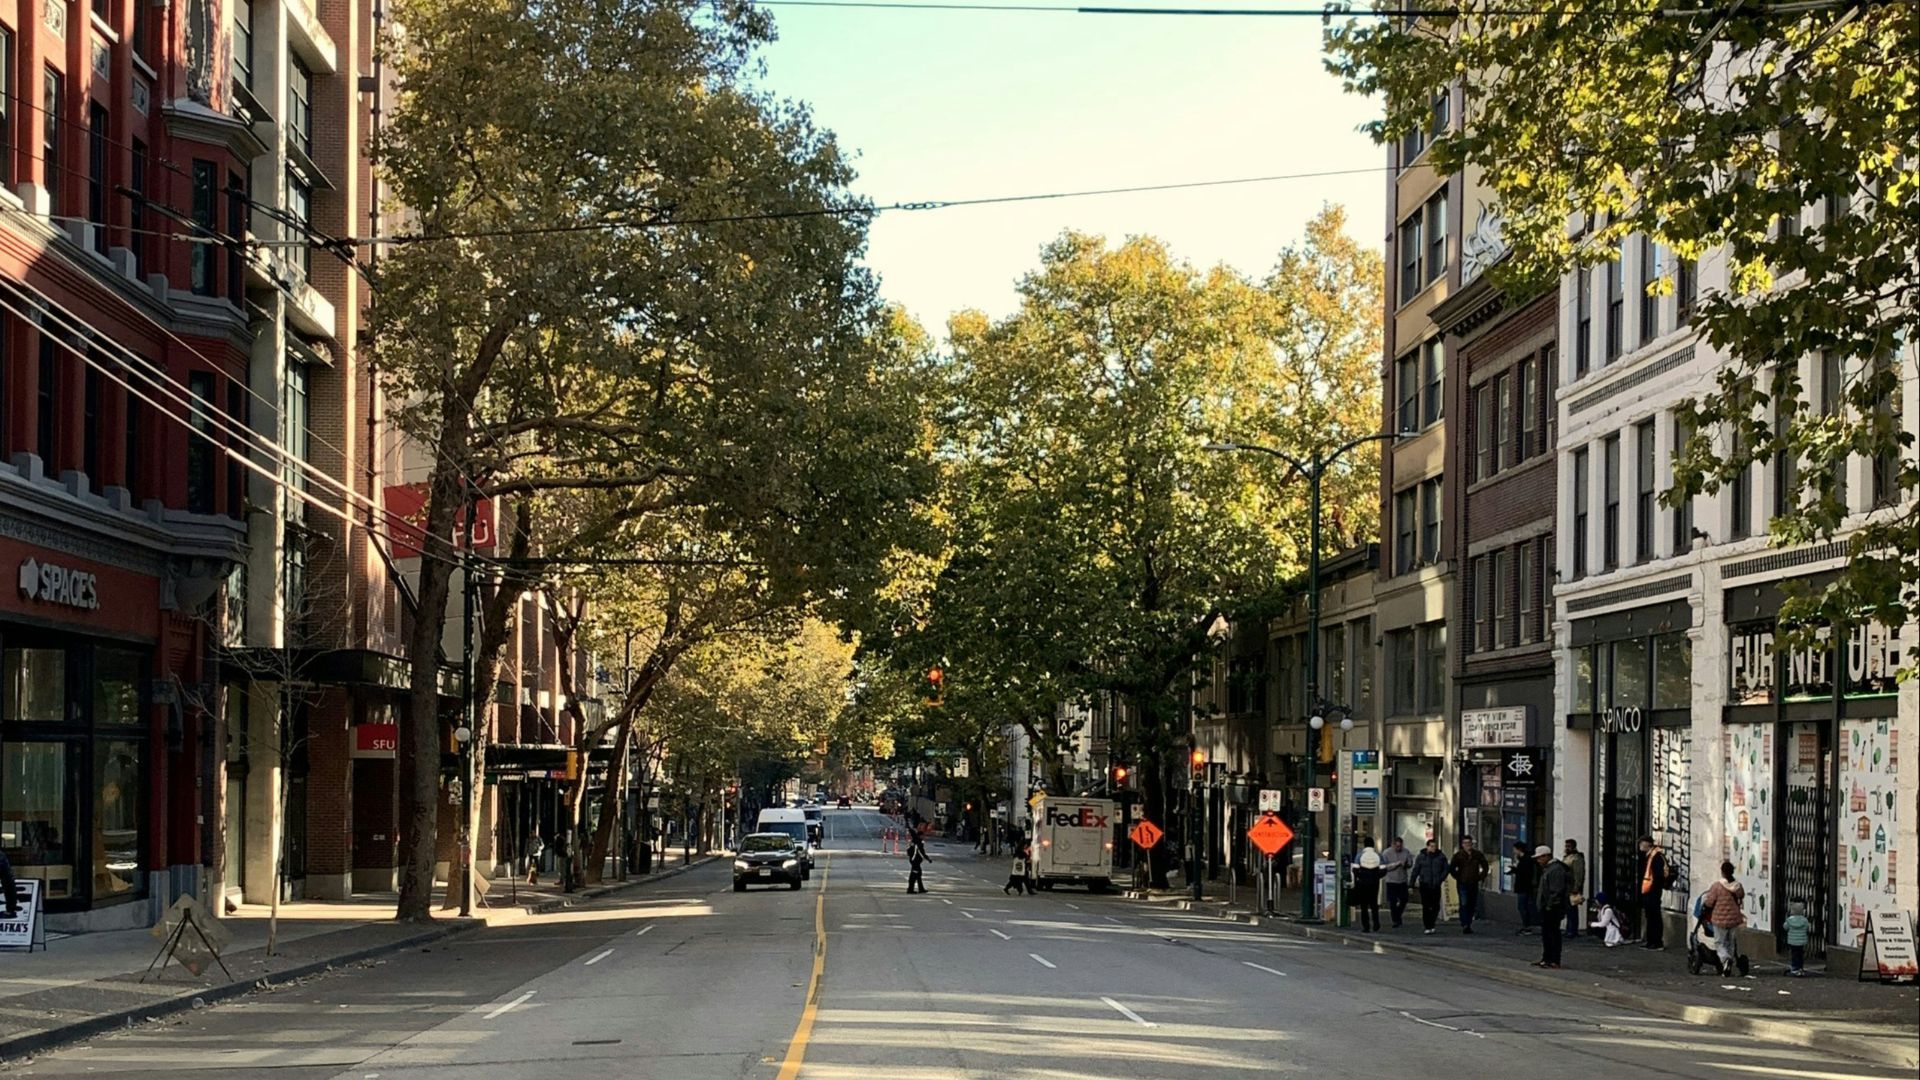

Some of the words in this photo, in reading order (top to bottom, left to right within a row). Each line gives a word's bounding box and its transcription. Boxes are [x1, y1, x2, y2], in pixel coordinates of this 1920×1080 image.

[1600, 707, 1641, 733] SPINCO
[373, 739, 395, 750] SFU
[1652, 728, 1660, 830] CONNECTION
[1668, 730, 1681, 832] PRIDE
[1046, 807, 1109, 828] FedEx
